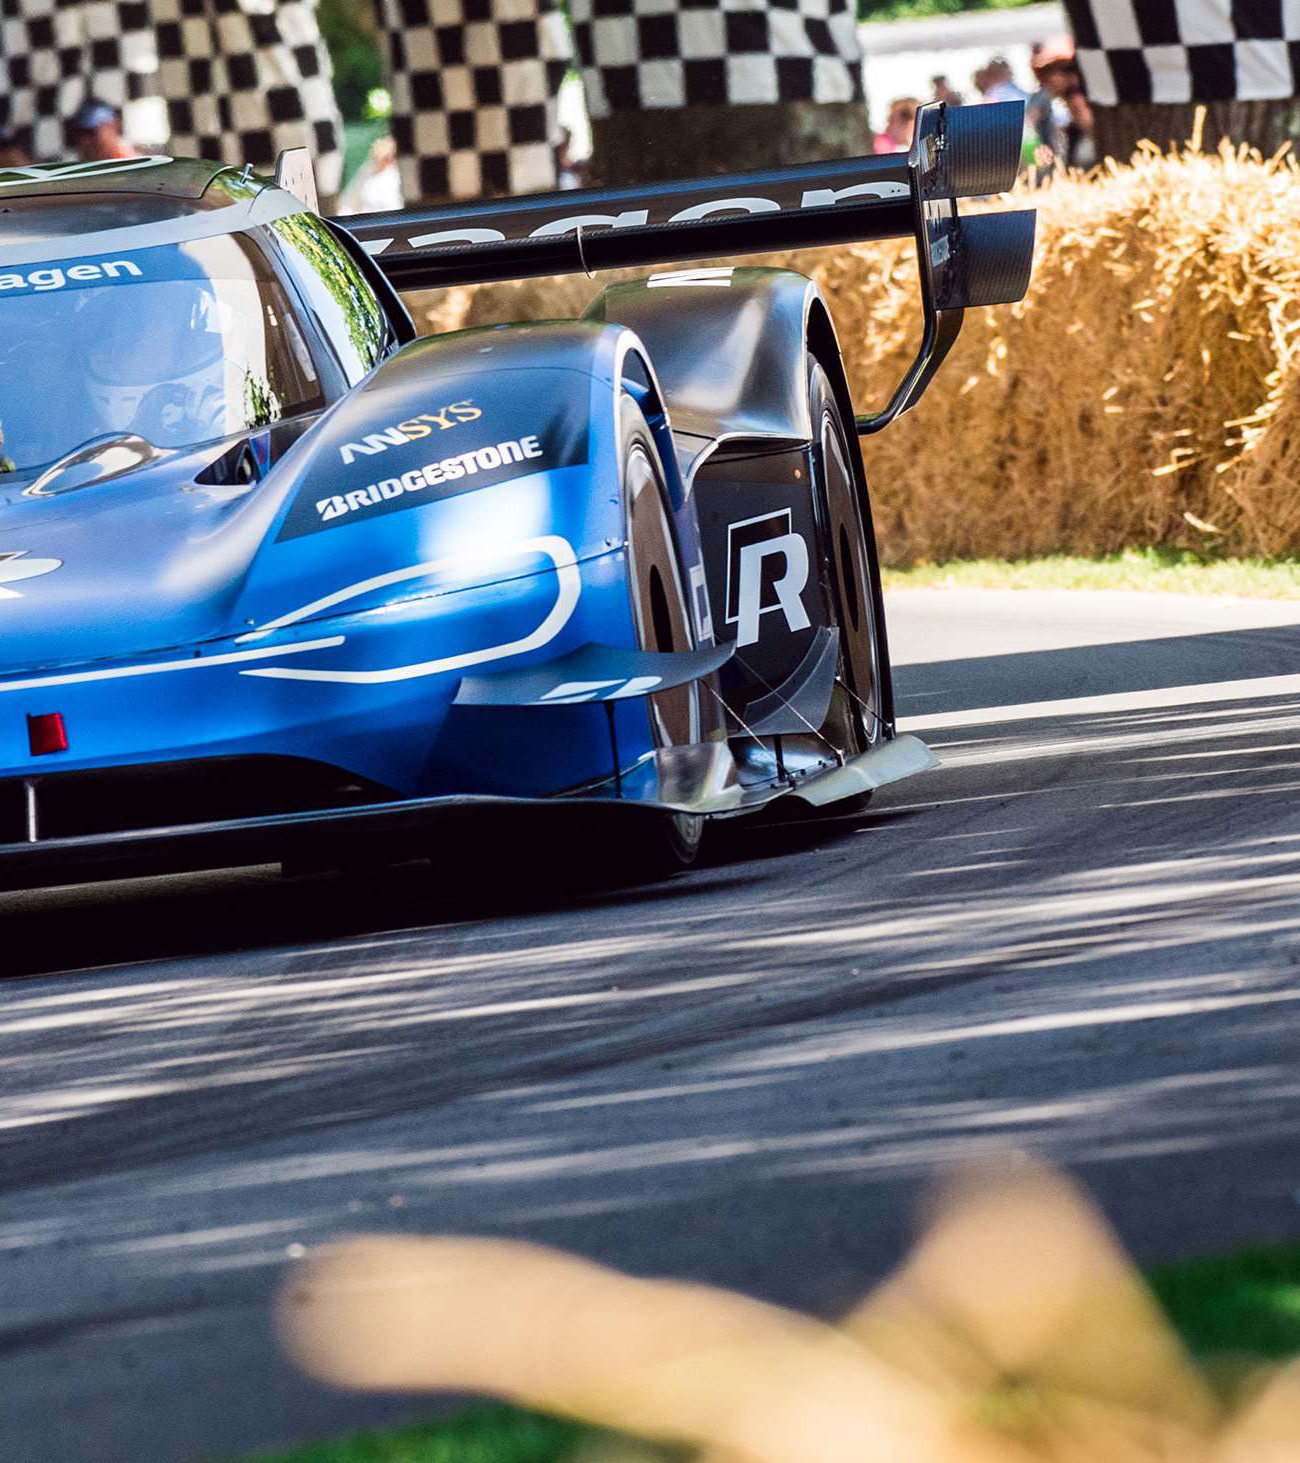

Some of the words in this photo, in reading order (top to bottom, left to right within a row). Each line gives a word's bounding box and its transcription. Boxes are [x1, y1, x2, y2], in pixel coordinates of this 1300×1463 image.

[339, 400, 483, 465] ANSYS
[315, 435, 544, 521] BRIDGESTONE
[725, 507, 812, 648] R
